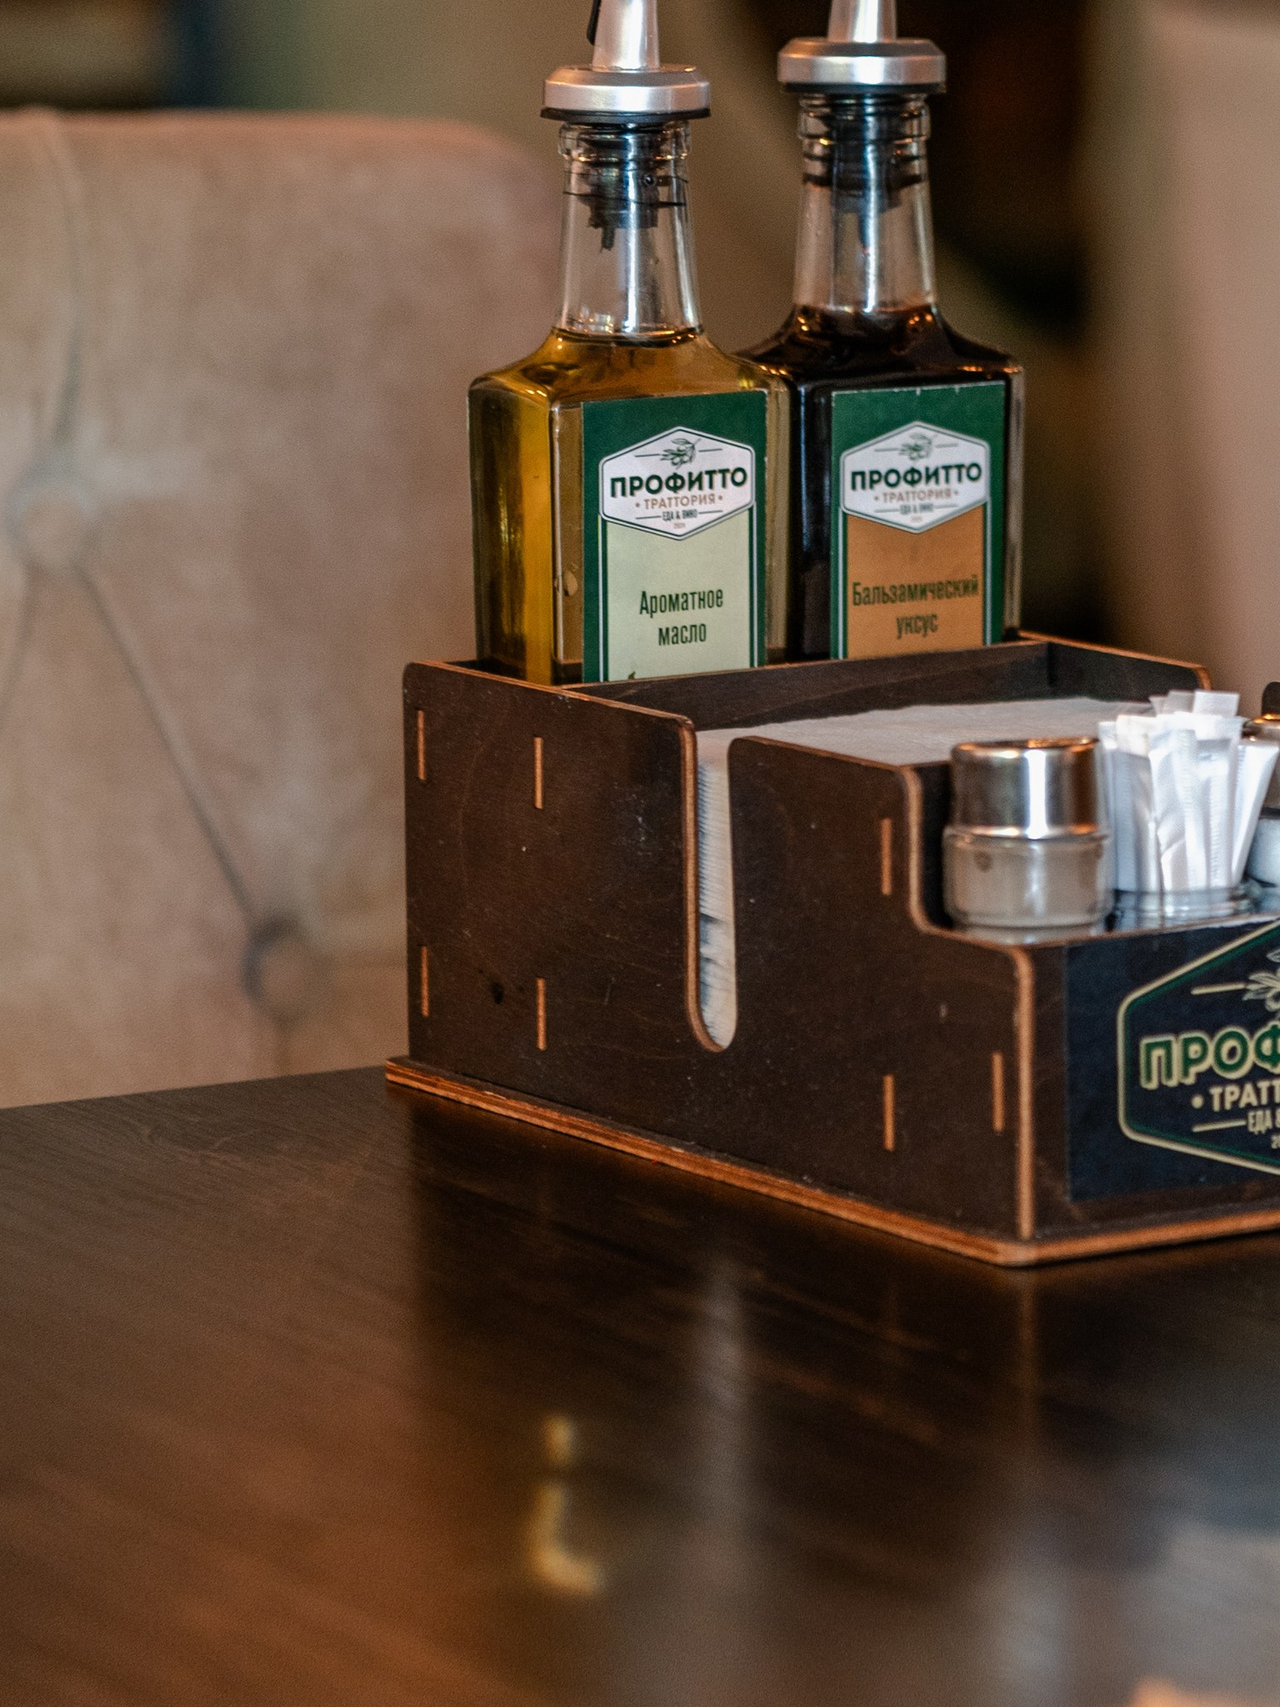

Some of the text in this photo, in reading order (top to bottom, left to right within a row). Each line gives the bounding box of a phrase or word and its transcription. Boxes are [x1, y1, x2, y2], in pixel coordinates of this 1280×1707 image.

[610, 467, 748, 498] ПРОФИТТО
[852, 463, 982, 491] ПРОФИТТО
[644, 494, 716, 510] ТРАТТОРИЯ
[882, 488, 952, 503] ТРАТТОРИЯ
[852, 574, 978, 606] Бальзамический
[639, 589, 724, 619] Ароматное
[658, 623, 707, 646] масло
[896, 614, 938, 640] уксус
[1247, 1109, 1273, 1135] ЕДА
